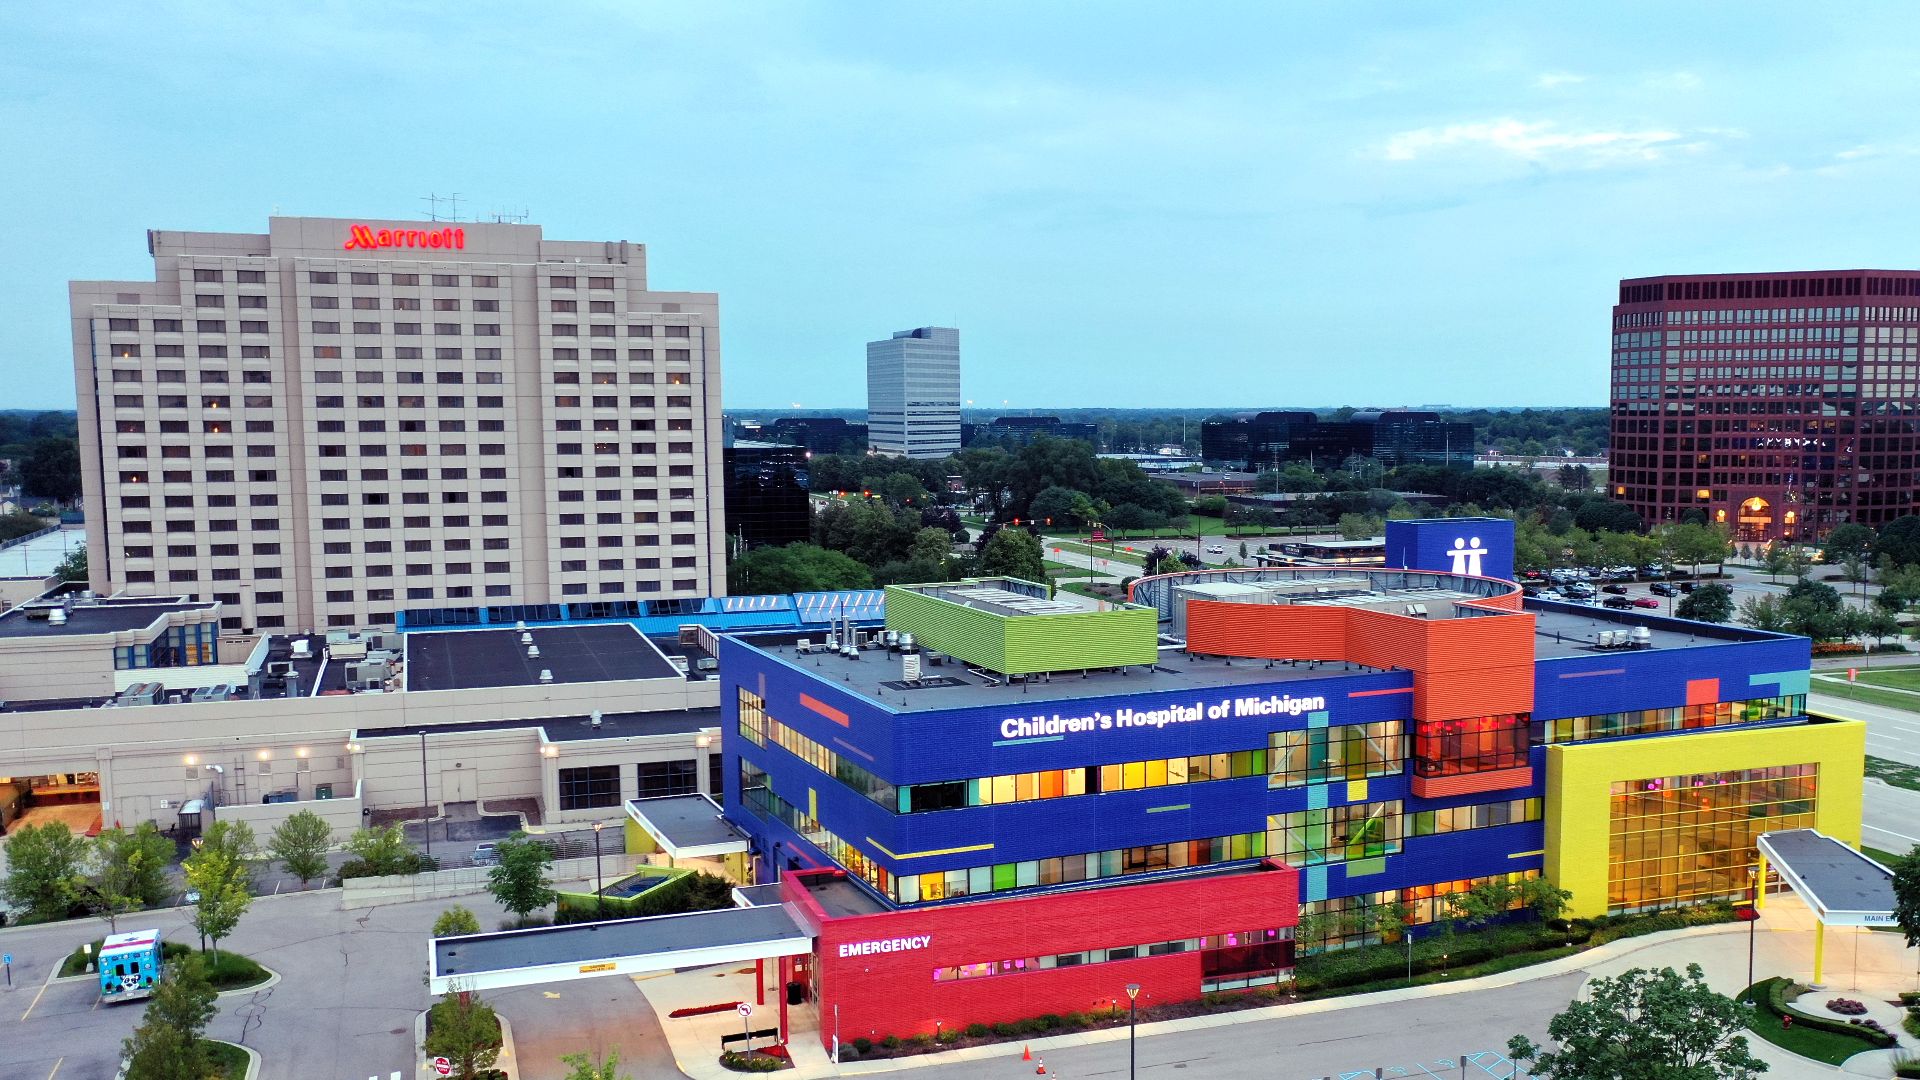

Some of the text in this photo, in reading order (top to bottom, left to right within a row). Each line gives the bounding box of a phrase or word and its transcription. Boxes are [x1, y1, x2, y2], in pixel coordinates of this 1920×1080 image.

[344, 224, 465, 250] Marriott
[1000, 695, 1325, 738] Children's Hospital of Michigan
[839, 935, 931, 958] EMERGENCY
